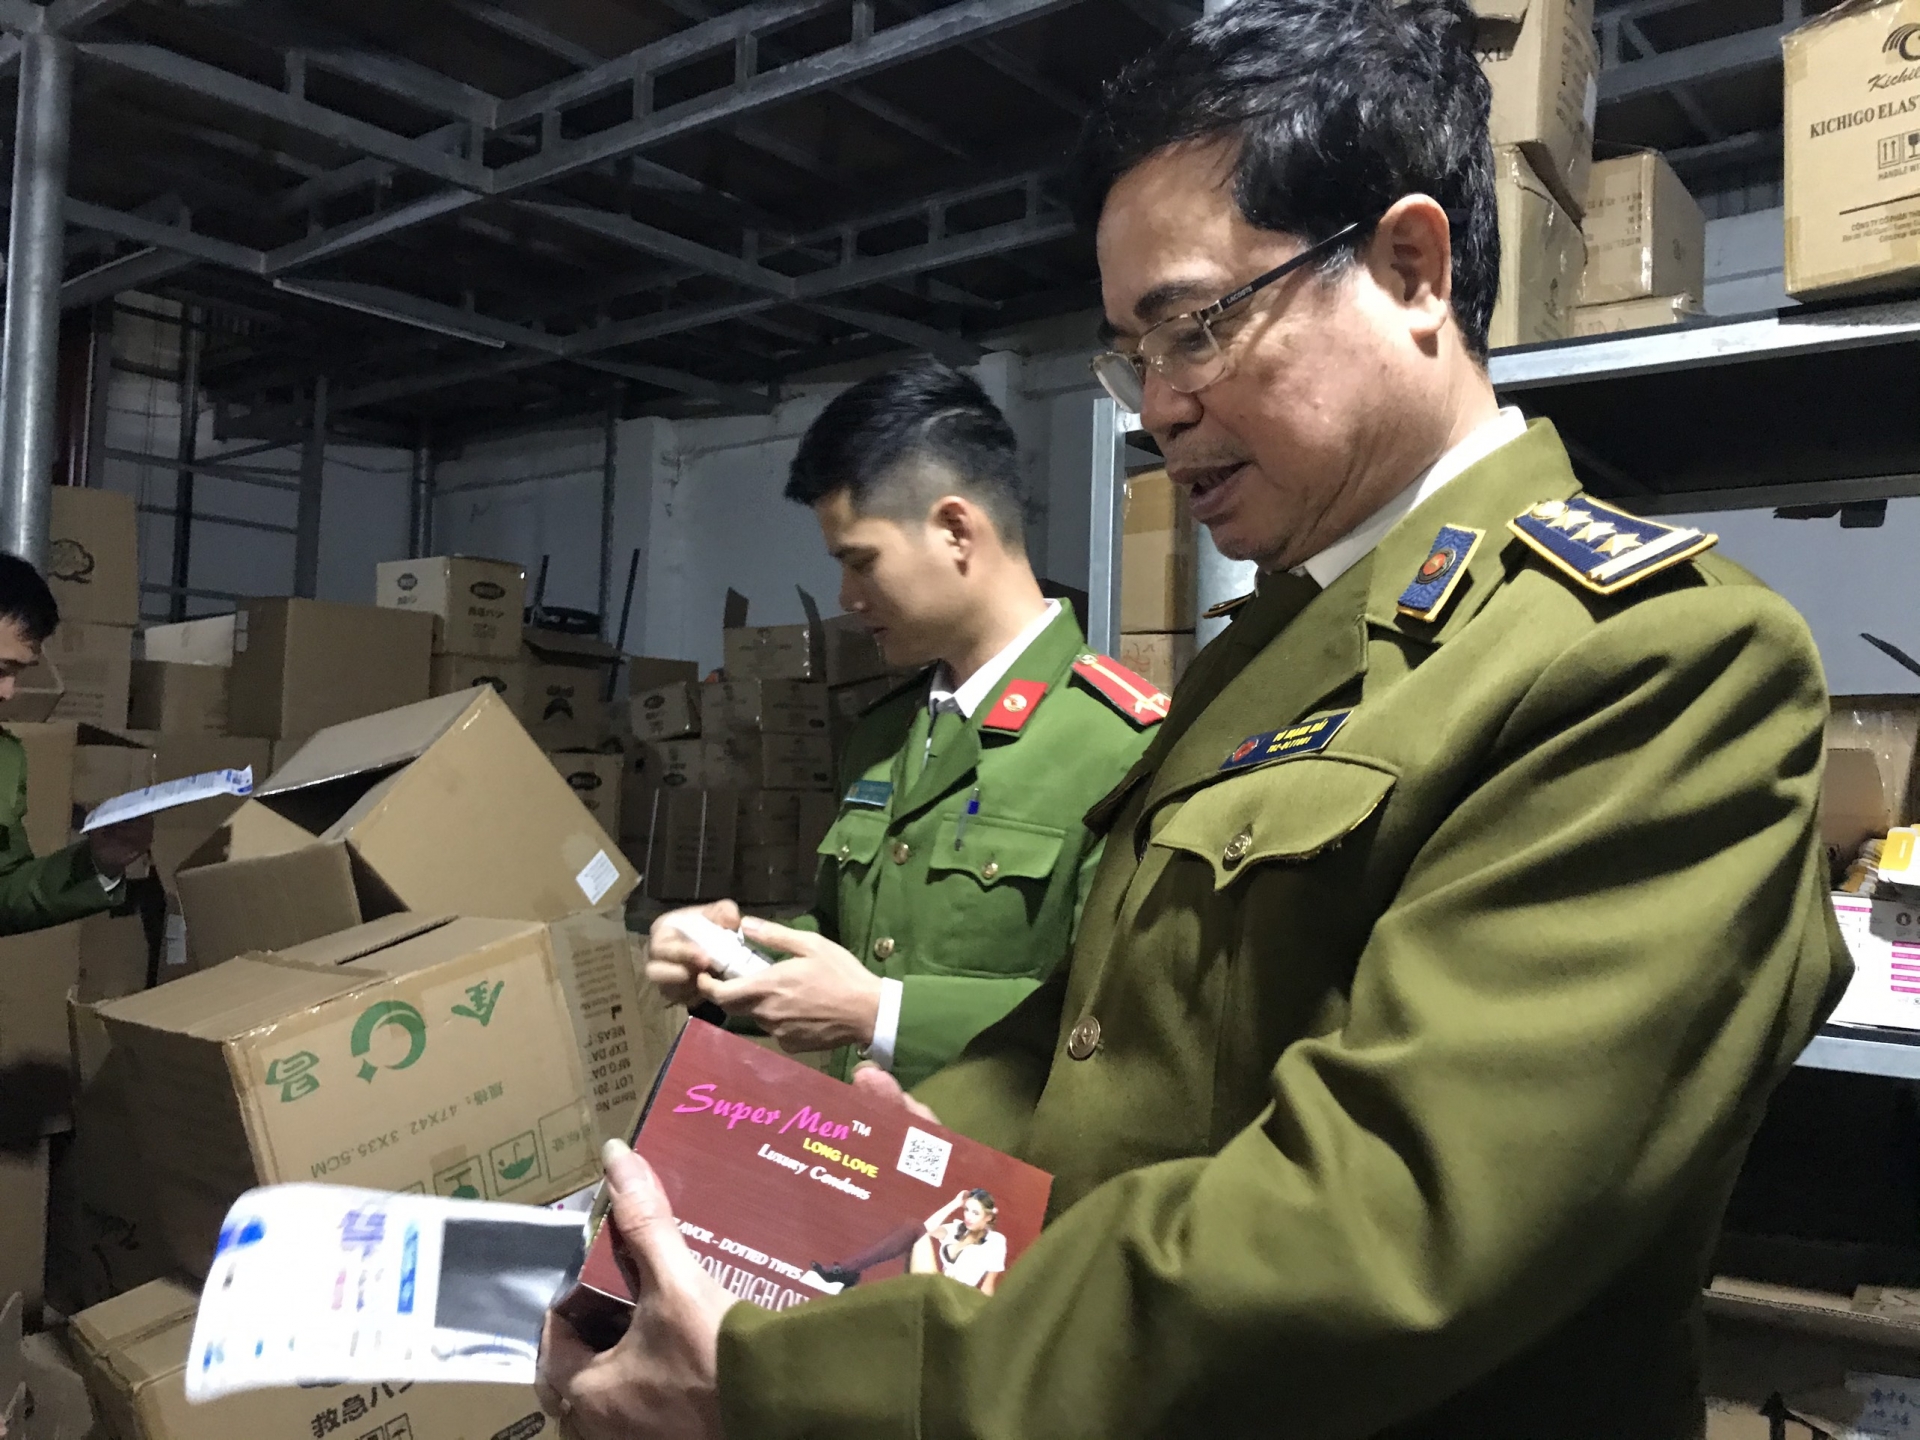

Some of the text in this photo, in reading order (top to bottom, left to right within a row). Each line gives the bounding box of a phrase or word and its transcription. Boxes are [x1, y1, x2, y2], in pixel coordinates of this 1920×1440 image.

[1810, 107, 1875, 139] KICHIGO
[672, 1083, 782, 1130] Super
[777, 1105, 850, 1141] Men
[757, 1143, 872, 1201] Luxury Condoms
[803, 1137, 880, 1178] LONG LOVE
[673, 1217, 715, 1244] AVOR
[718, 1238, 770, 1266] DOTTED
